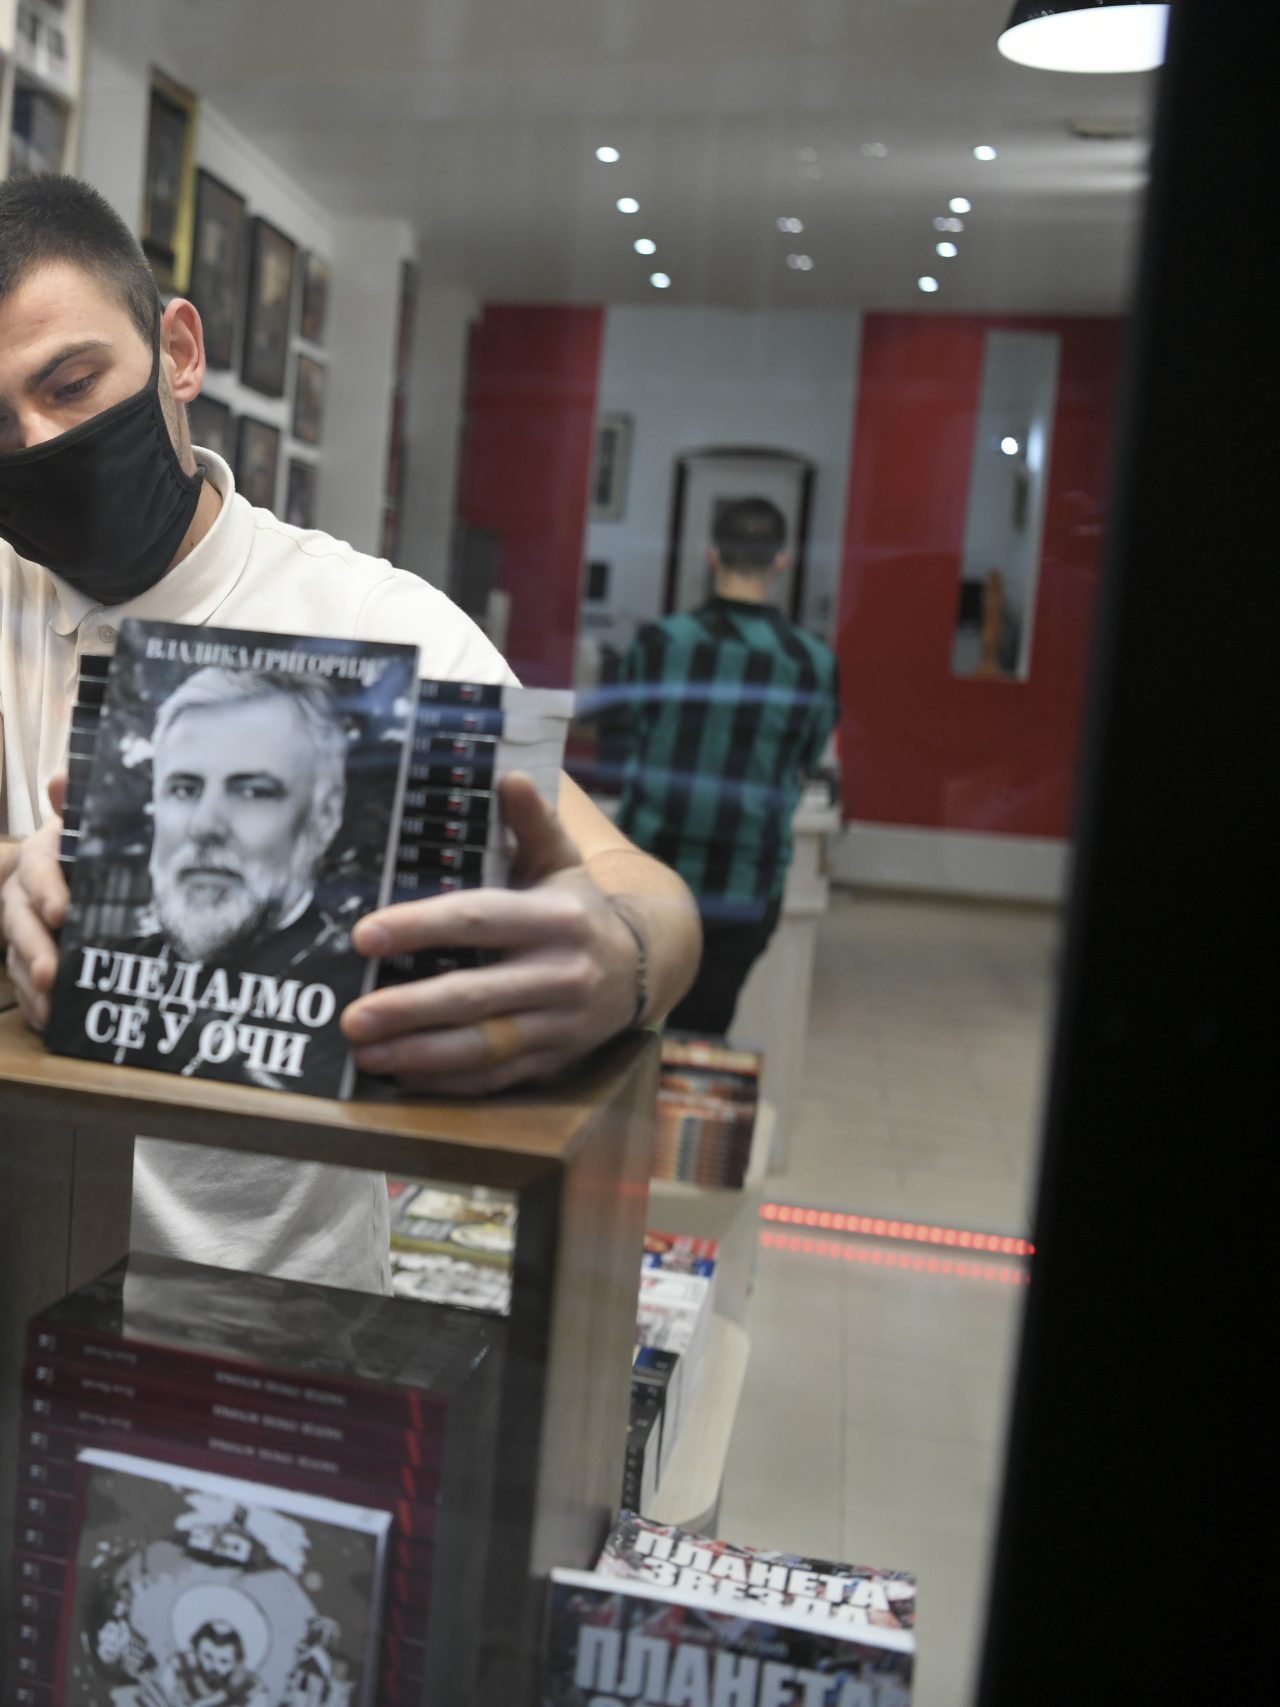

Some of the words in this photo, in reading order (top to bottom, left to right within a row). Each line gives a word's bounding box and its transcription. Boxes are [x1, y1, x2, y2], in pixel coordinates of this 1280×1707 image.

[75, 945, 336, 1028] ГЛЕДАЈМО
[85, 1000, 147, 1049] СЕ
[157, 1009, 192, 1053] У
[198, 1019, 311, 1078] ОЧИ
[633, 1530, 890, 1611] ПЛАНЕТА
